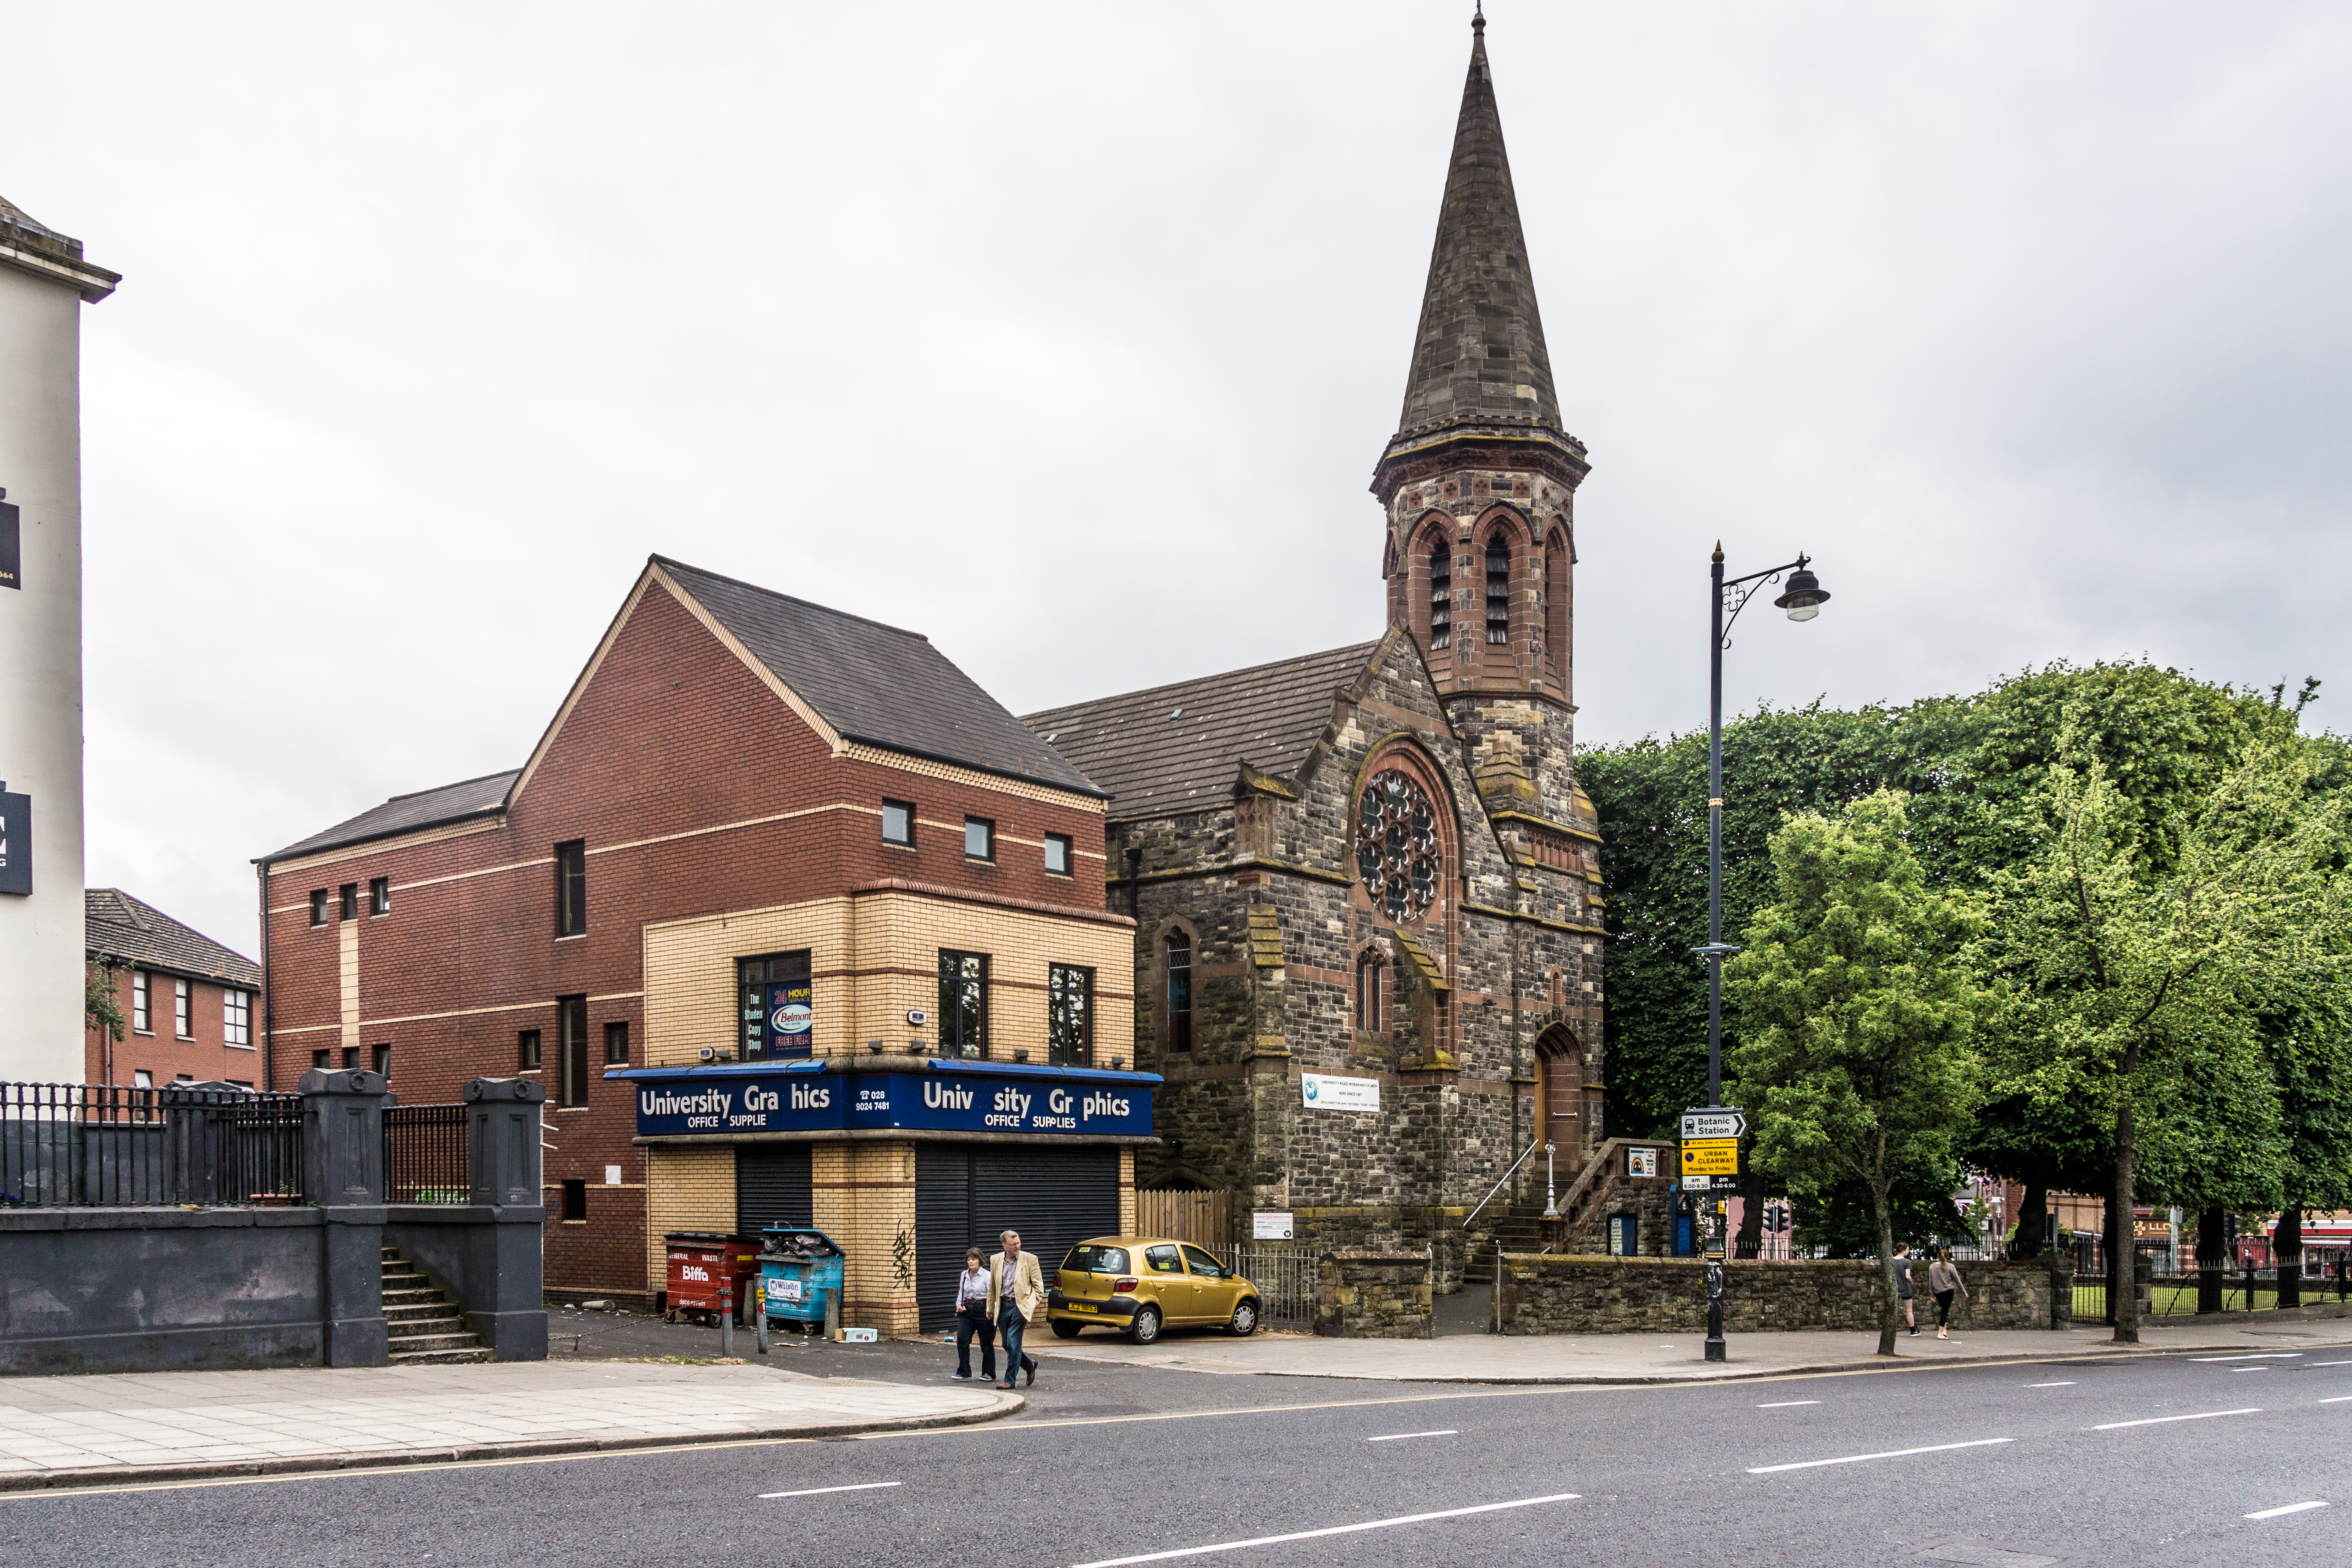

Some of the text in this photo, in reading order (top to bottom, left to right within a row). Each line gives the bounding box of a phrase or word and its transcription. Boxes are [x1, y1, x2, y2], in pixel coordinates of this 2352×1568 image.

[750, 994, 759, 1004] The
[775, 988, 811, 1004] 24 HOUR
[745, 1009, 762, 1020] Studen
[780, 1012, 811, 1023] Belmont
[748, 1025, 761, 1036] Copy
[748, 1040, 761, 1051] Shop
[776, 1034, 809, 1046] FREE FILM
[871, 1091, 885, 1099] 028
[642, 1089, 731, 1118] University
[856, 1101, 889, 1111] 9024 7481
[688, 1114, 766, 1128] OFFICE SUPPLIE
[985, 1114, 1076, 1129] OFFICE SUPPLIES
[682, 1265, 709, 1281] Biffa
[777, 1281, 798, 1290] Wilson
